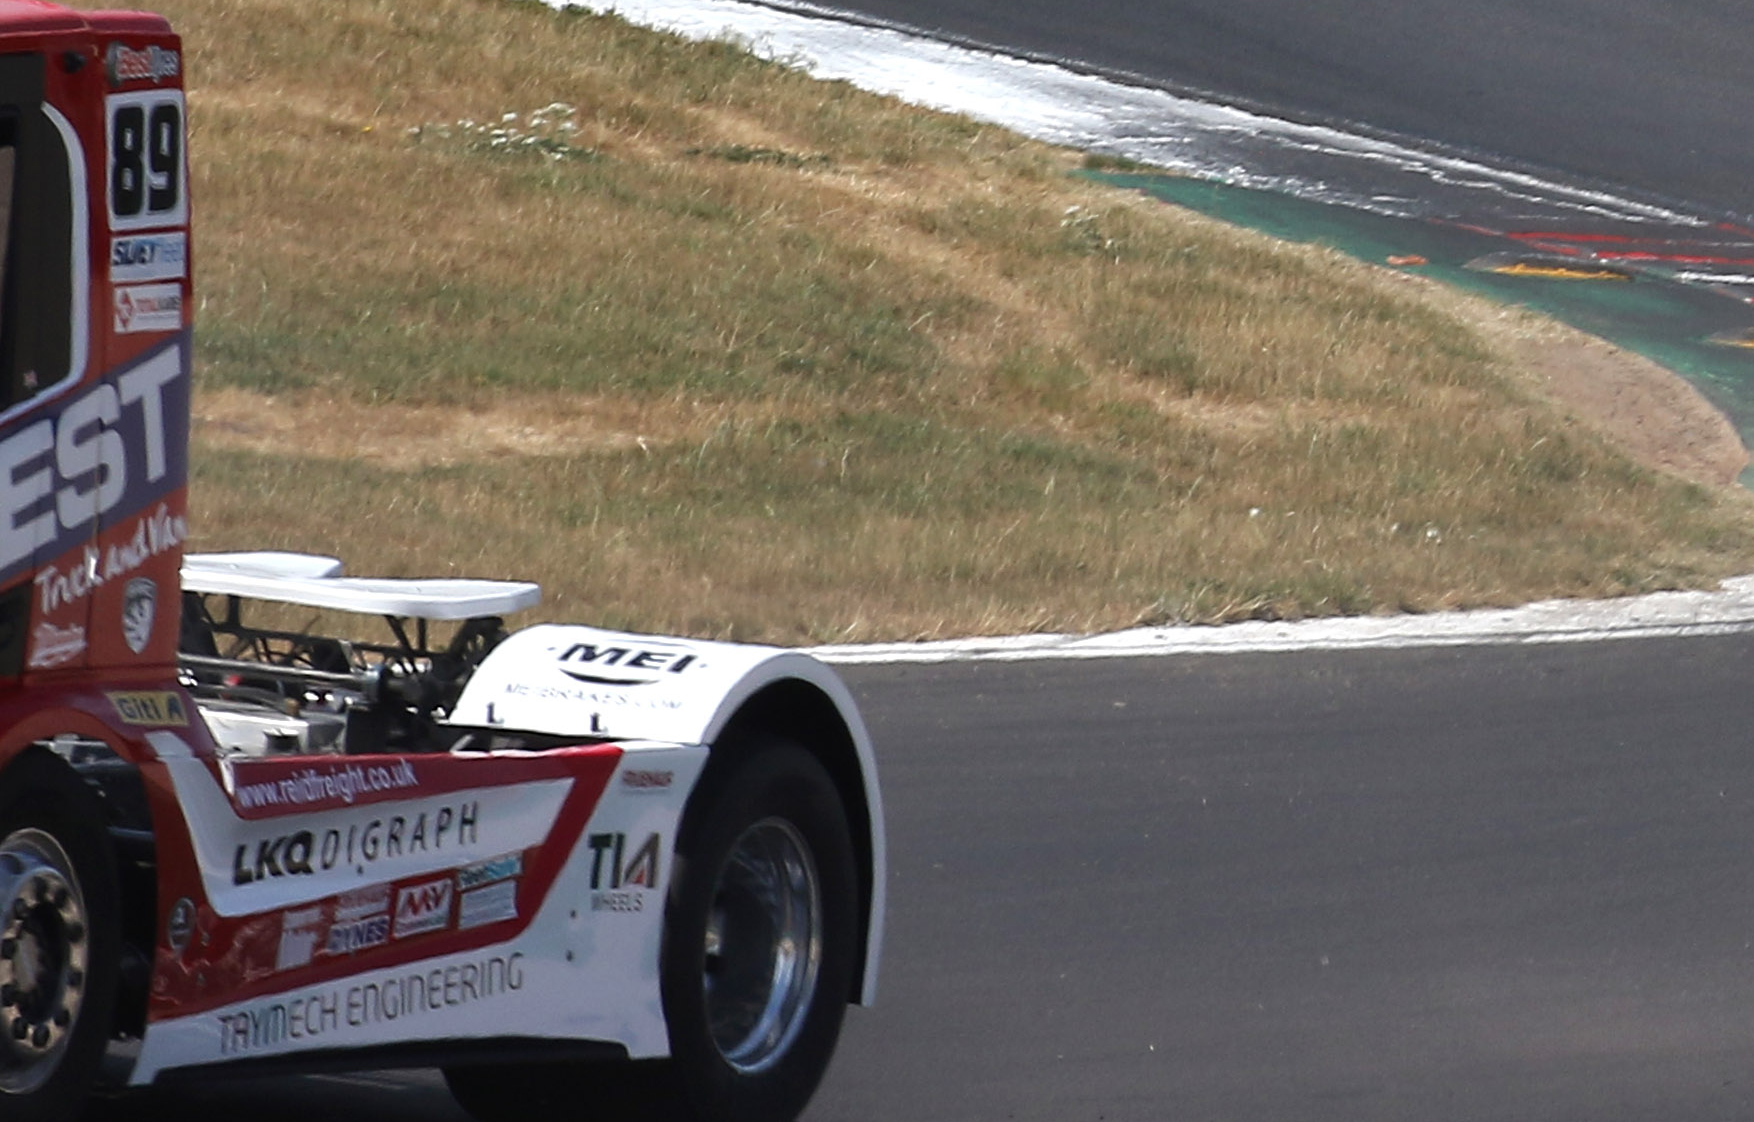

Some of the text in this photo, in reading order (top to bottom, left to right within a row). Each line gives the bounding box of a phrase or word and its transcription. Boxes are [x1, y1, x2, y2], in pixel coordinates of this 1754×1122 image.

[112, 102, 181, 217] 89
[557, 643, 699, 674] MEI
[232, 800, 480, 887] LKQ DIGRAPH
[346, 951, 525, 1026] ENGINEERING
